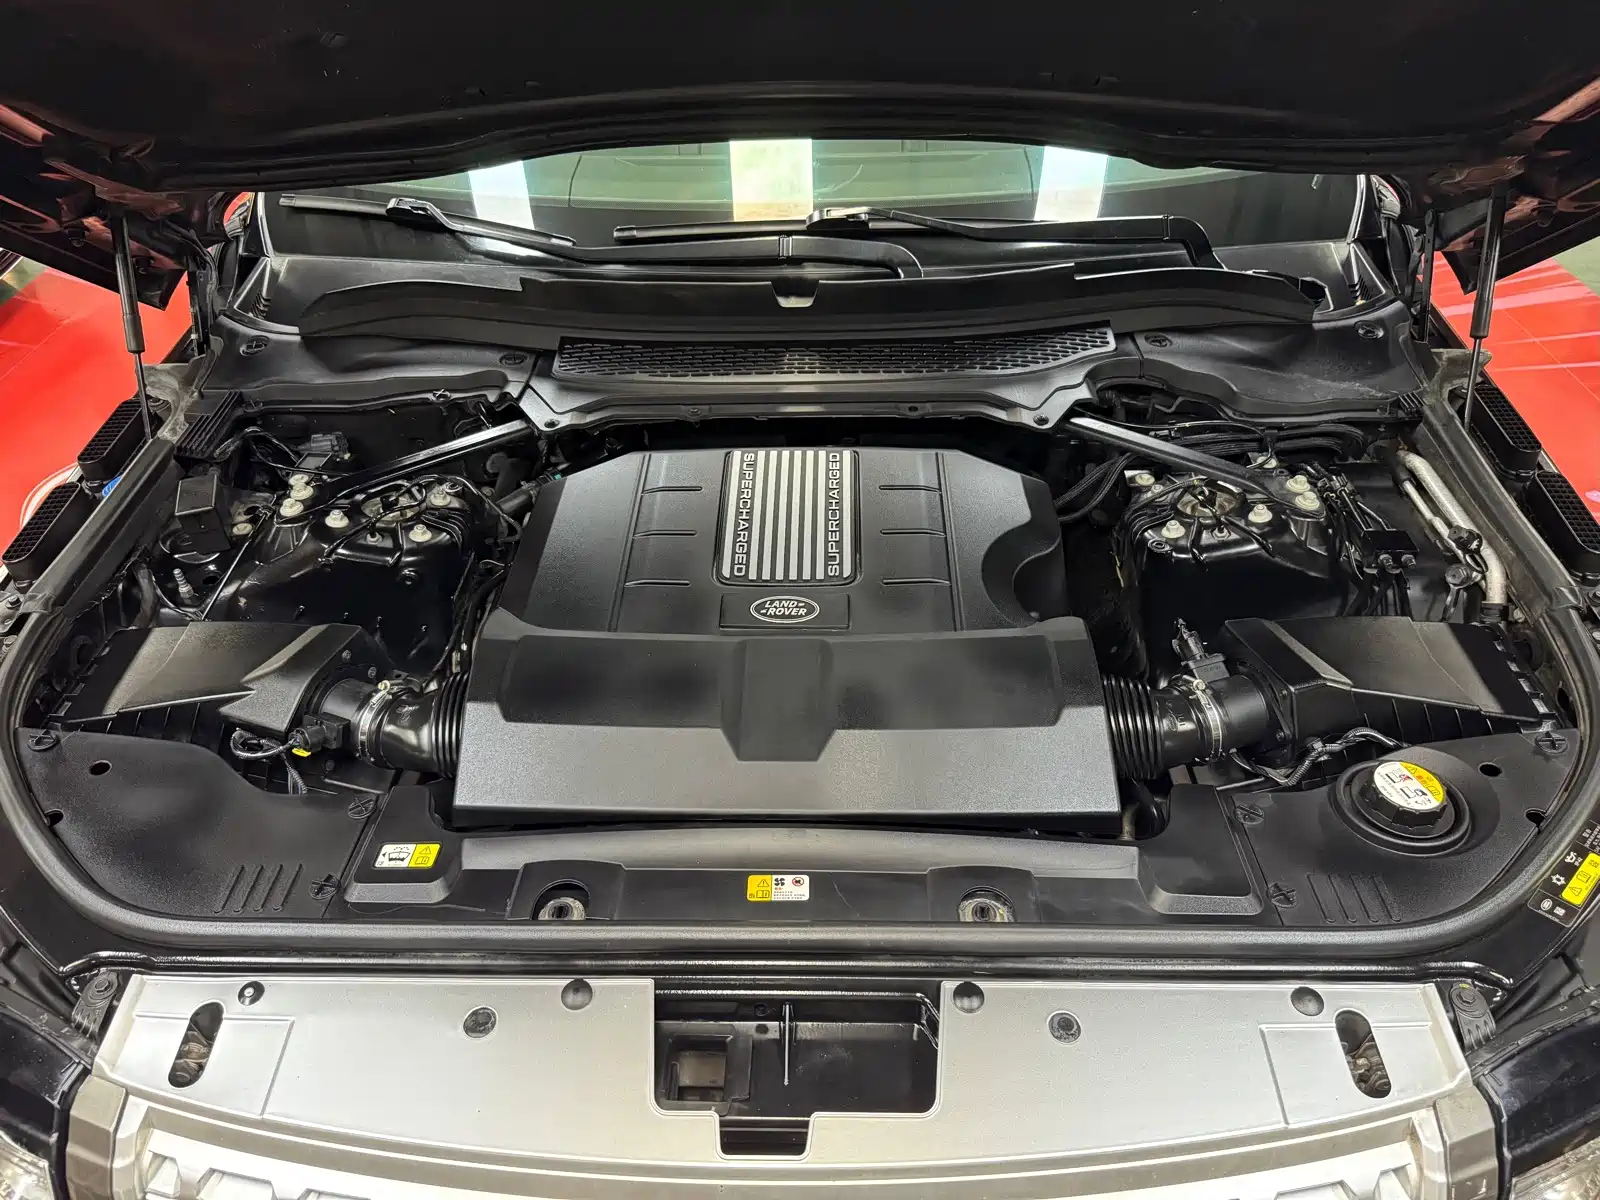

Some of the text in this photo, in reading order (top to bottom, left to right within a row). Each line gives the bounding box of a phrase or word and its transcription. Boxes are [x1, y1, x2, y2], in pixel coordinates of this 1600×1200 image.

[733, 452, 755, 577] SUPERCHARGED
[827, 452, 840, 577] SUPERCHARGED
[764, 600, 798, 608] LAND
[766, 607, 808, 616] ROVER
